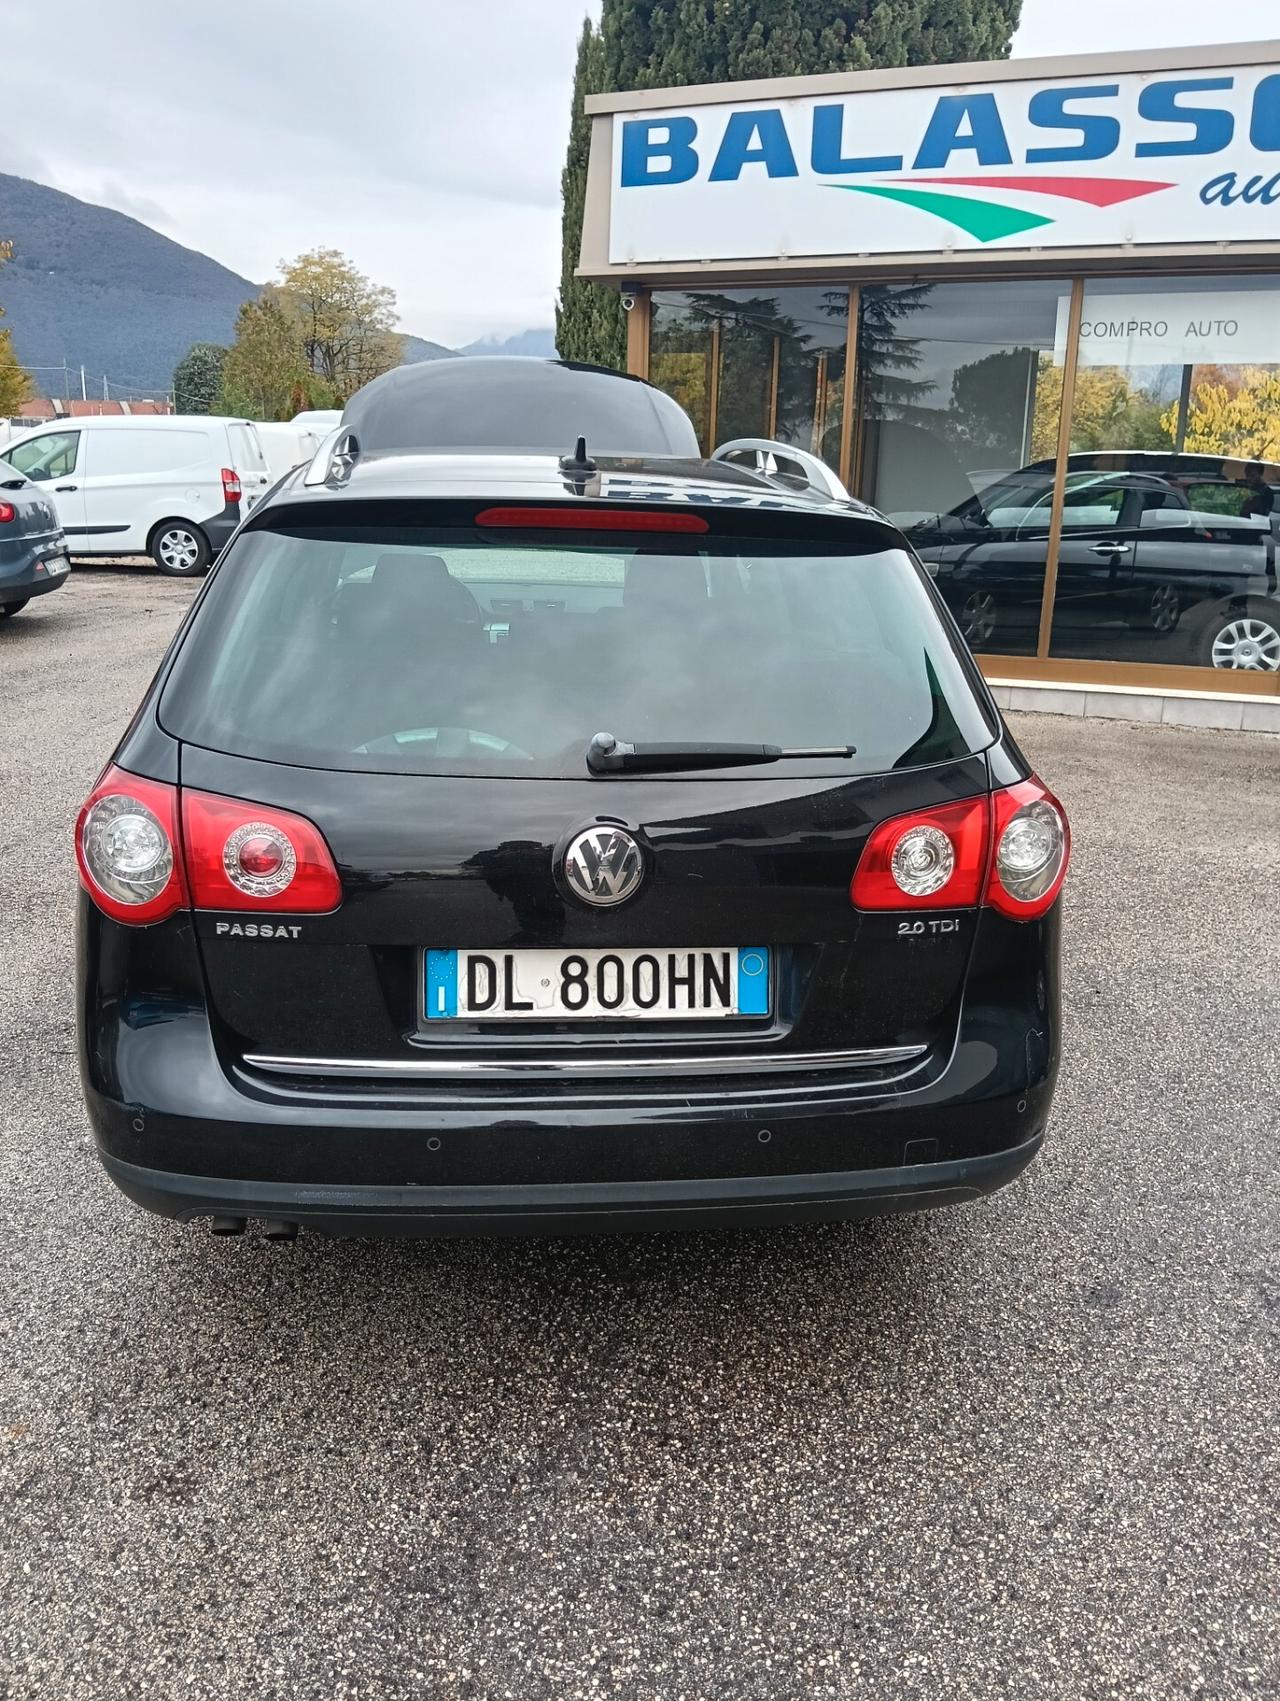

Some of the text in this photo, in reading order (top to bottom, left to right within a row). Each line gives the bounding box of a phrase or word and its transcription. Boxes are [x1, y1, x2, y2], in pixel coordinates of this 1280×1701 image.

[1079, 320, 1238, 338] COMPRO AUTO
[216, 922, 302, 938] PASSAT
[467, 952, 731, 1011] DL 800HN
